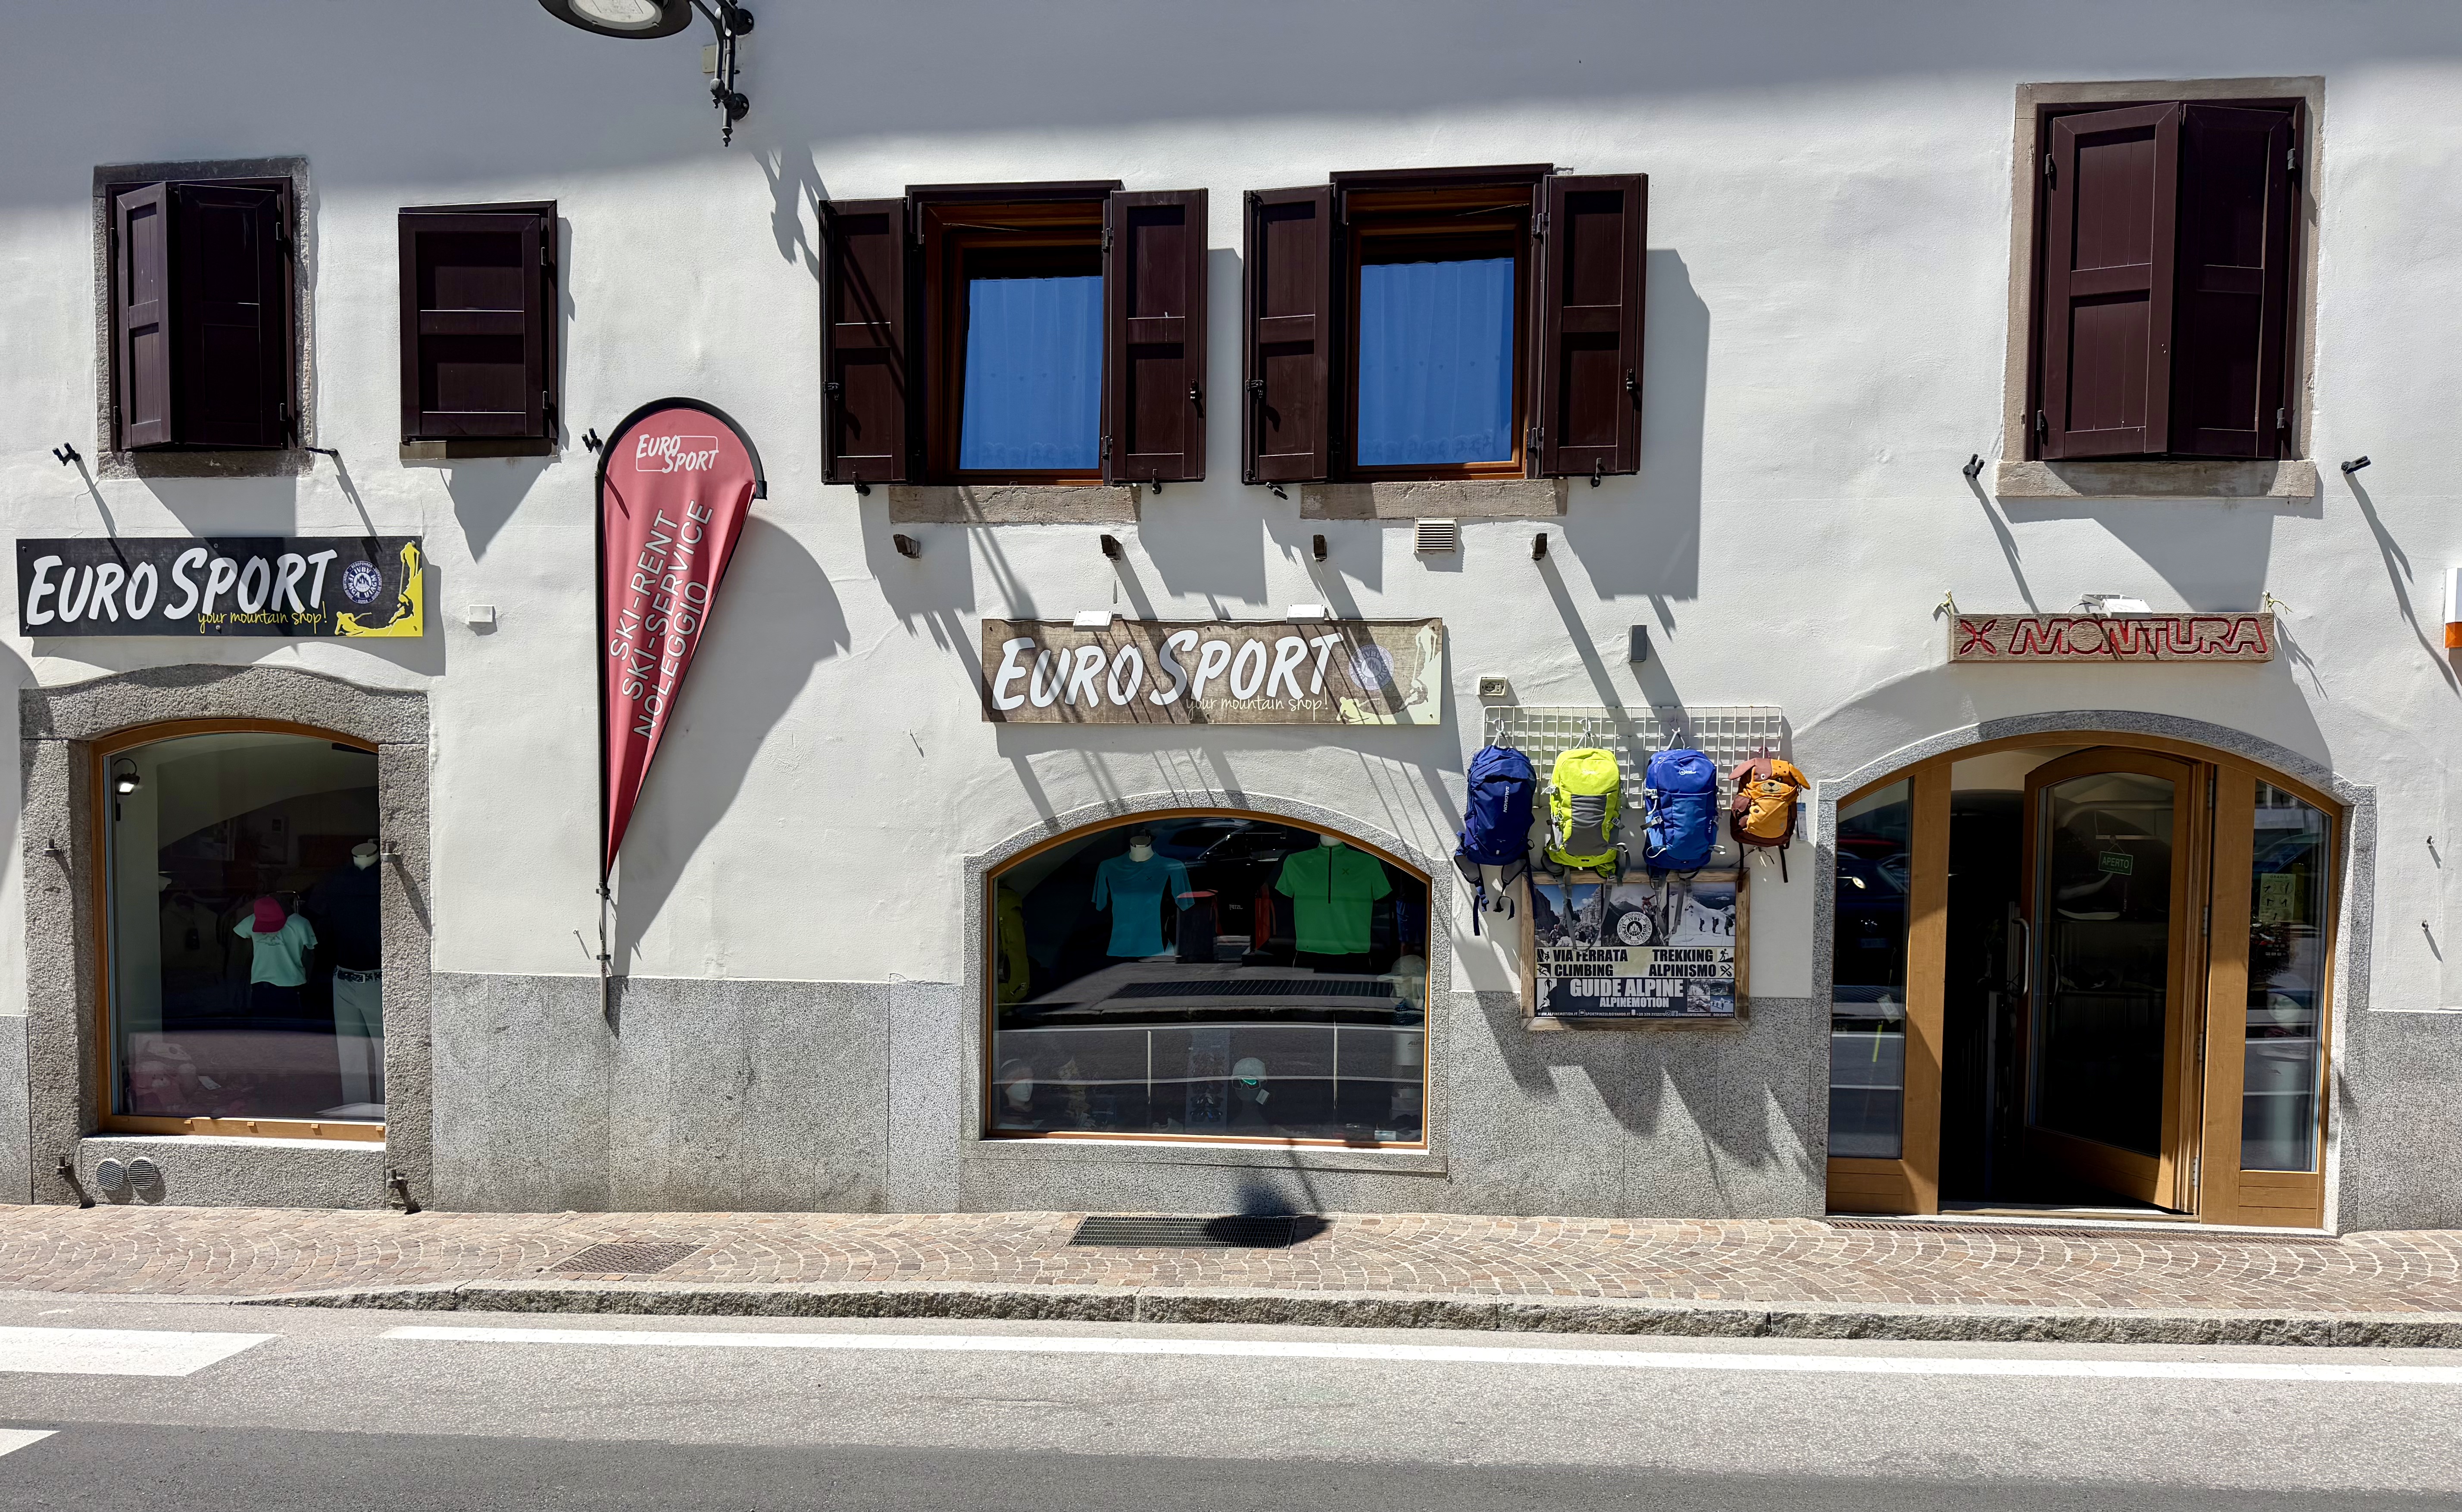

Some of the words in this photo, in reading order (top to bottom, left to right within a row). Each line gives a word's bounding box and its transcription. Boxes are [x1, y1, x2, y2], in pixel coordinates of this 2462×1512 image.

[637, 434, 681, 458] EURO
[662, 450, 719, 473] SPORT
[27, 555, 158, 625] EURO
[163, 547, 337, 620] SPORT
[610, 509, 678, 661] SKI-RENT
[622, 500, 713, 700] SKI-SERVICE
[198, 611, 227, 634] your
[231, 609, 288, 624] mountain
[291, 600, 327, 634] shop!
[2009, 617, 2268, 655] MONTURA
[634, 581, 709, 740] NOLEGGIO
[992, 637, 1143, 711] EURO
[1149, 630, 1343, 706] SPORT
[1186, 698, 1217, 720] your
[1221, 695, 1284, 710] mountain
[1288, 687, 1328, 721] shop!
[2102, 856, 2129, 868] APERTO
[1553, 949, 1573, 962] VIA
[1576, 949, 1628, 962] FERRATA
[1652, 949, 1713, 962] TREKKING
[1554, 964, 1613, 976] CLIMBING
[1649, 964, 1716, 977] ALPINISMO
[1570, 979, 1622, 997] GUIDE
[1625, 979, 1684, 997] ALPINE
[1600, 997, 1669, 1007] ALPINEMOTION
